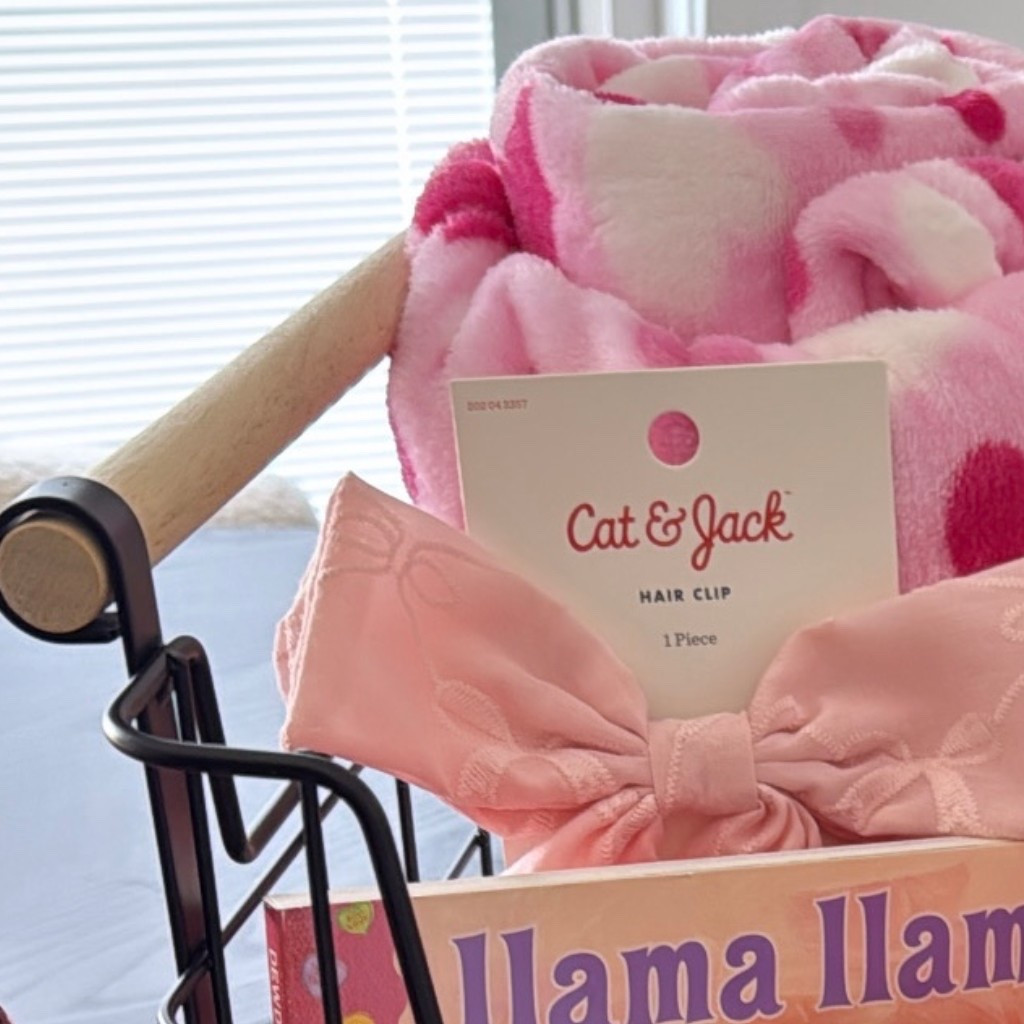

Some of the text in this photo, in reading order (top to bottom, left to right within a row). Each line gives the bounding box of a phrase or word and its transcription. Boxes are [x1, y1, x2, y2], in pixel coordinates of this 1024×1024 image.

[567, 489, 794, 572] Cat & Jack
[639, 585, 732, 605] HAIR CLIP
[663, 632, 718, 648] 1 Piece
